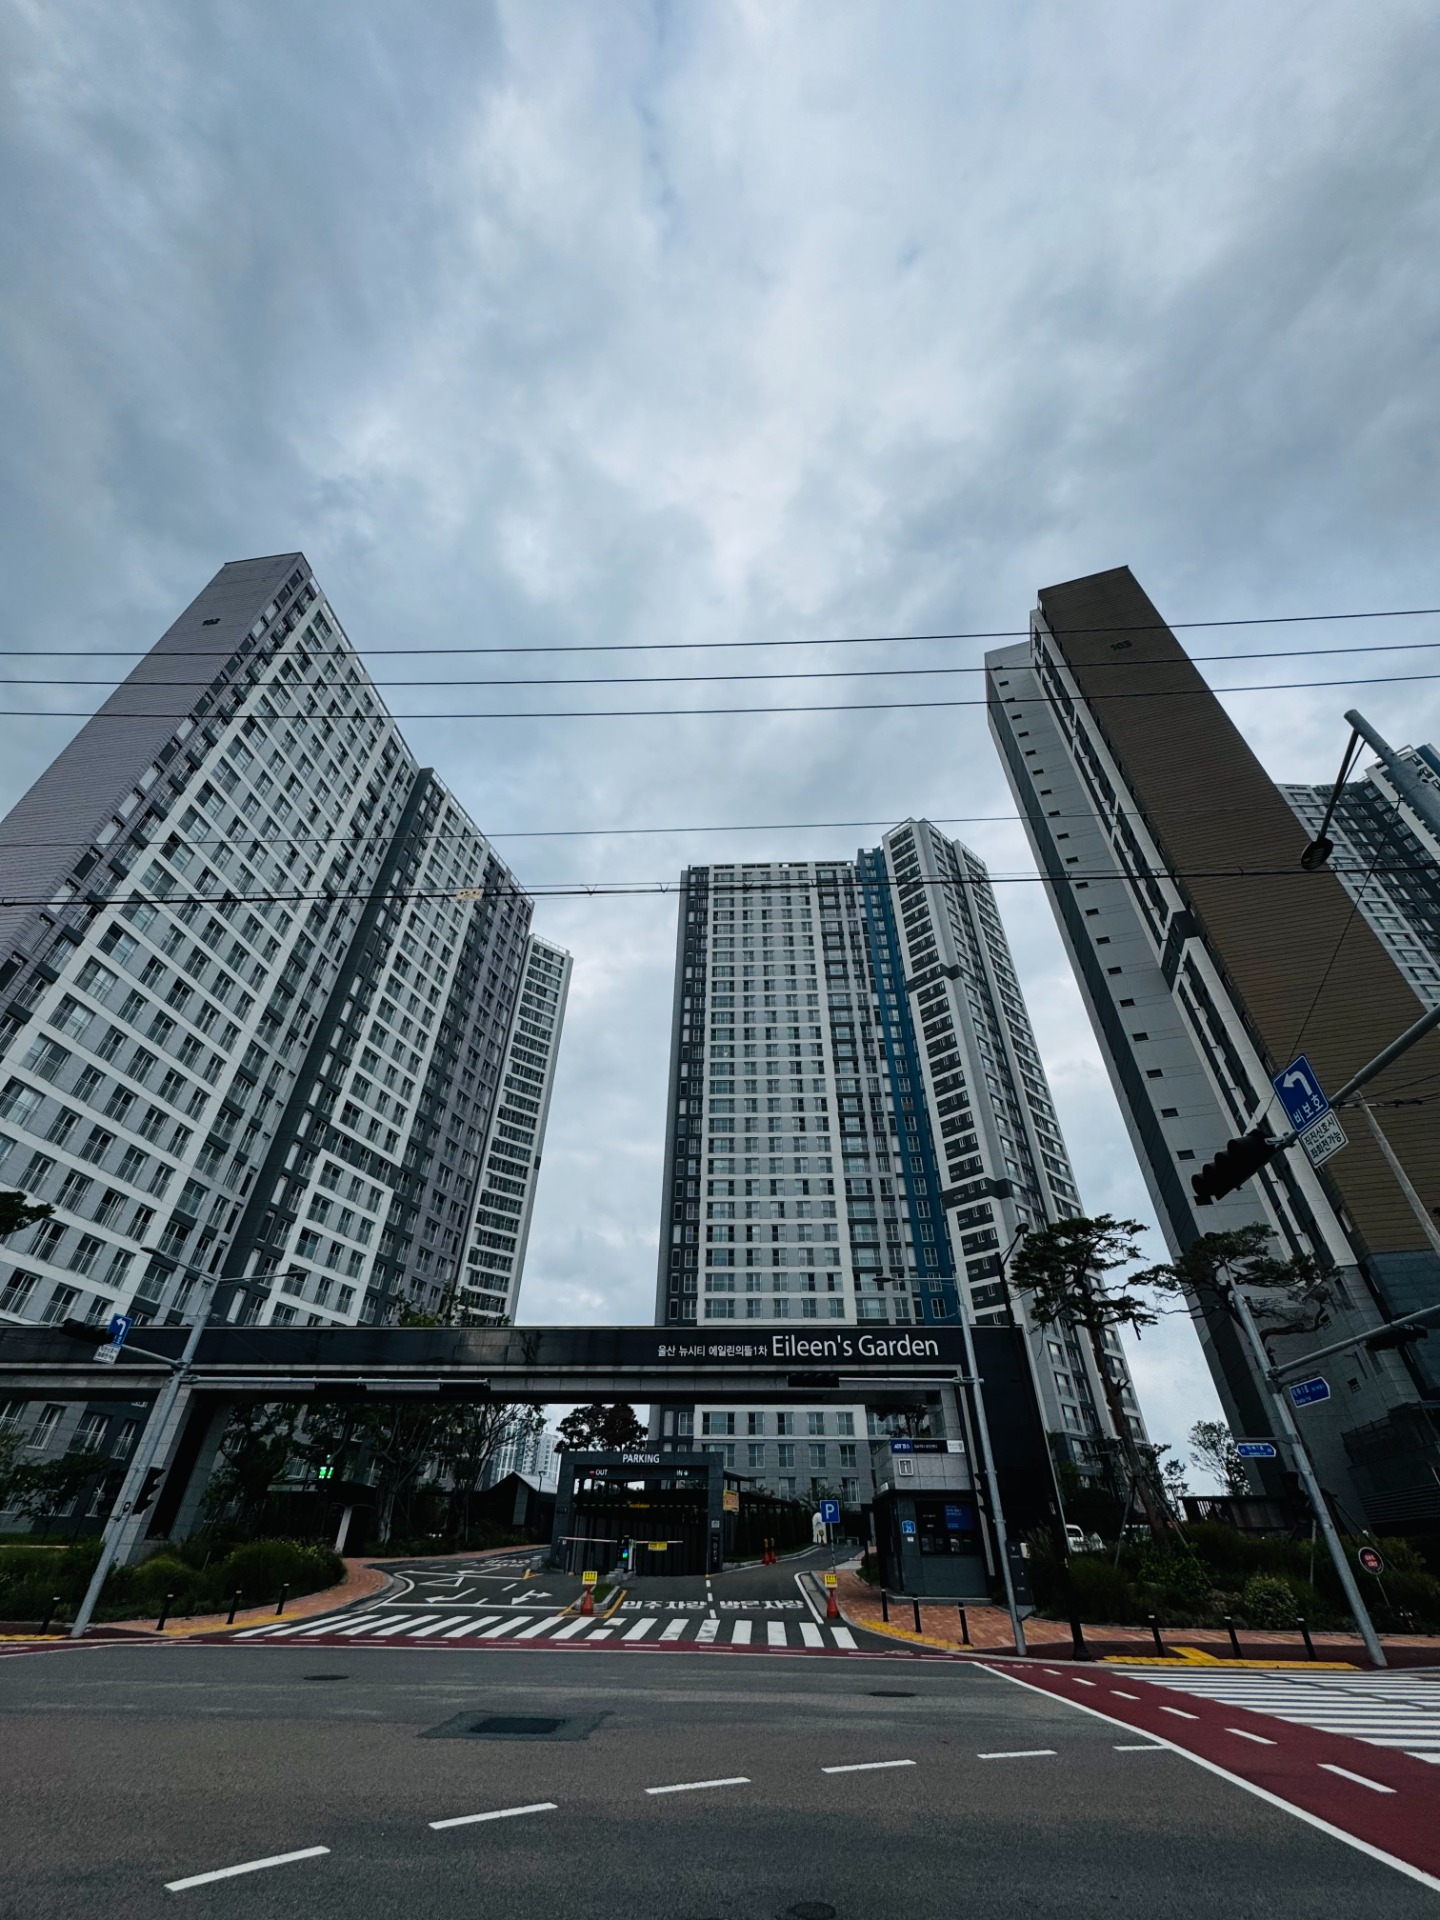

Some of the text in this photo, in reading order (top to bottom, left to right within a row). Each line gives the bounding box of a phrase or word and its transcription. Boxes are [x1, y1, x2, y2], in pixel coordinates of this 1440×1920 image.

[1110, 640, 1132, 650] 103
[1292, 1094, 1324, 1124] 비보호
[1303, 1116, 1336, 1146] 직진신호시
[1310, 1131, 1342, 1159] 좌회전가능
[658, 1334, 939, 1357] 울산 뉴시티 에일린의뜰1차 Eileen's Garden
[622, 1453, 660, 1464] PARKING
[825, 1503, 835, 1520] P
[620, 1600, 805, 1610] 입주차량 방문차량
